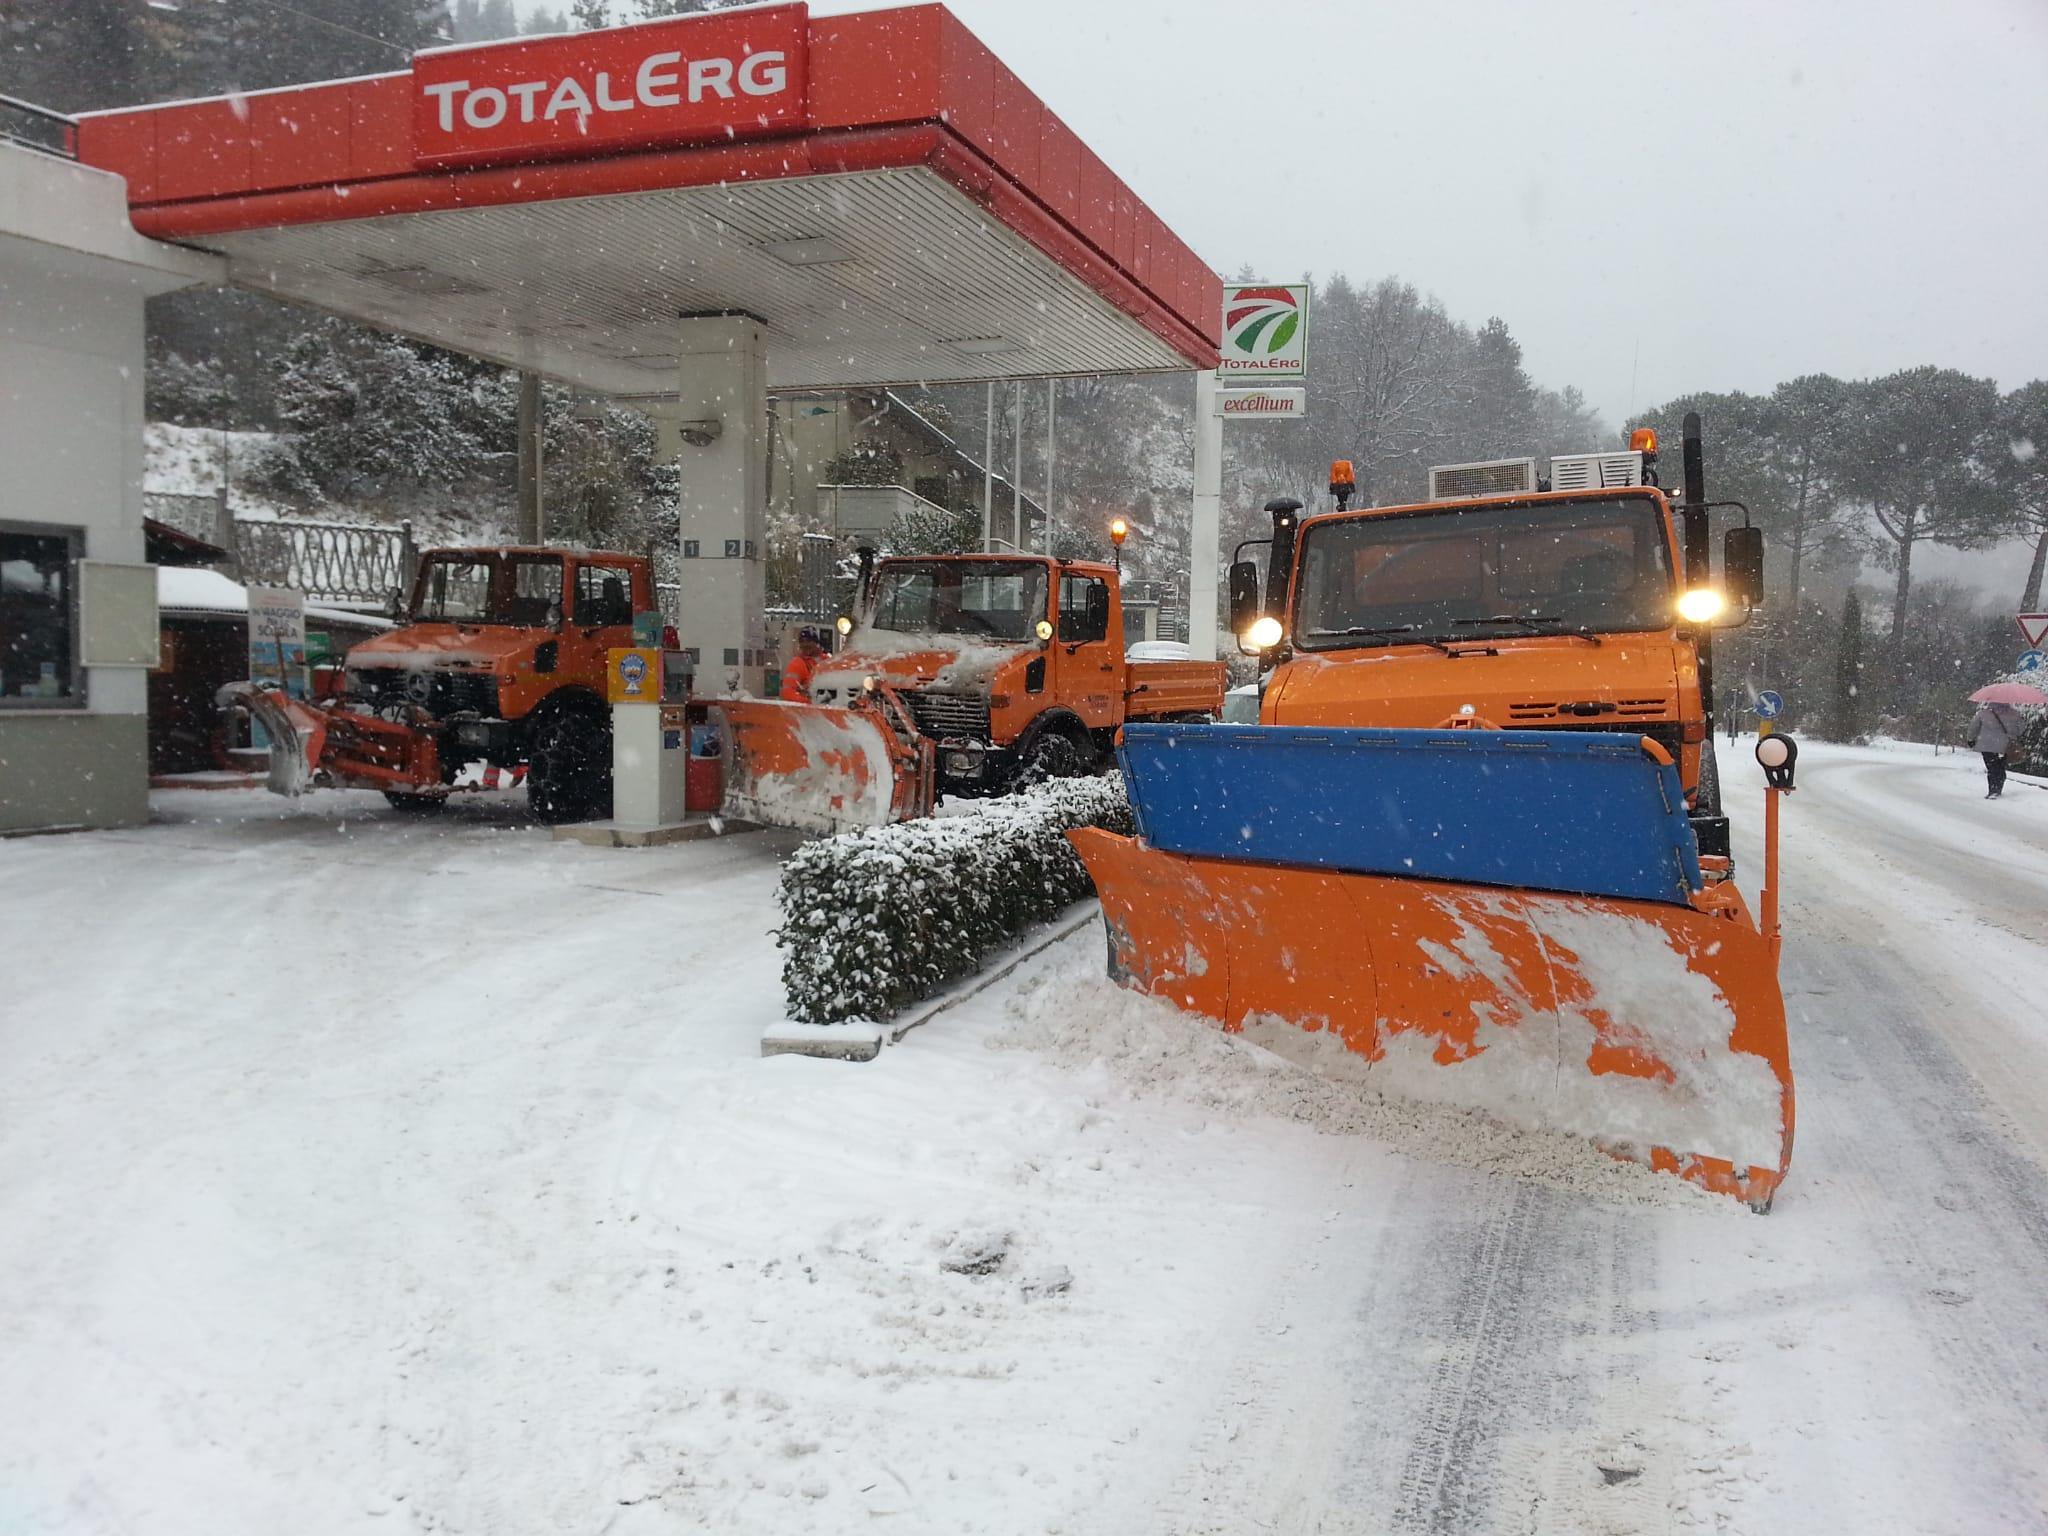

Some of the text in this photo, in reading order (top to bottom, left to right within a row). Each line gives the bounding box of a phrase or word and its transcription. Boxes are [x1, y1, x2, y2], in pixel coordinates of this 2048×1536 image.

[423, 50, 787, 132] TOTALERG
[1222, 358, 1300, 369] TOTALERG
[1224, 396, 1294, 411] excellium
[687, 541, 737, 556] 1 2
[262, 607, 301, 619] VIAGGIO
